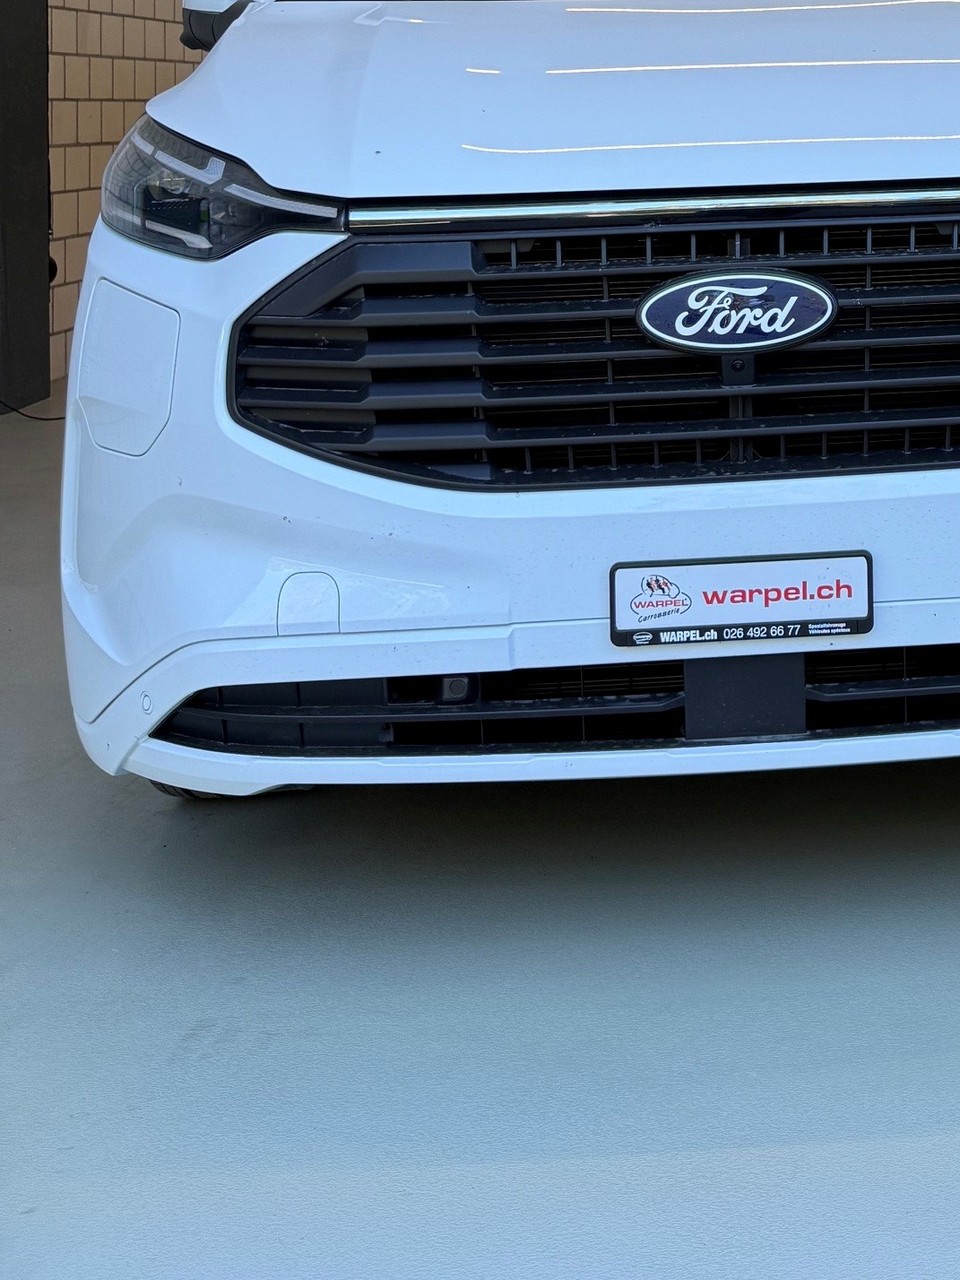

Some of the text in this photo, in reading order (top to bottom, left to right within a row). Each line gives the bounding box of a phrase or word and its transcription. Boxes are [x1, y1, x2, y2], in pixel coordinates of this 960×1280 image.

[675, 285, 798, 336] Ford
[702, 579, 853, 608] warpel.ch
[633, 599, 689, 609] WARPEL
[637, 607, 680, 623] Carrosserie
[660, 628, 718, 643] WARPEL.ch
[723, 627, 744, 639] 026
[746, 625, 767, 637] 492
[770, 624, 784, 636] 66
[787, 624, 801, 635] 77
